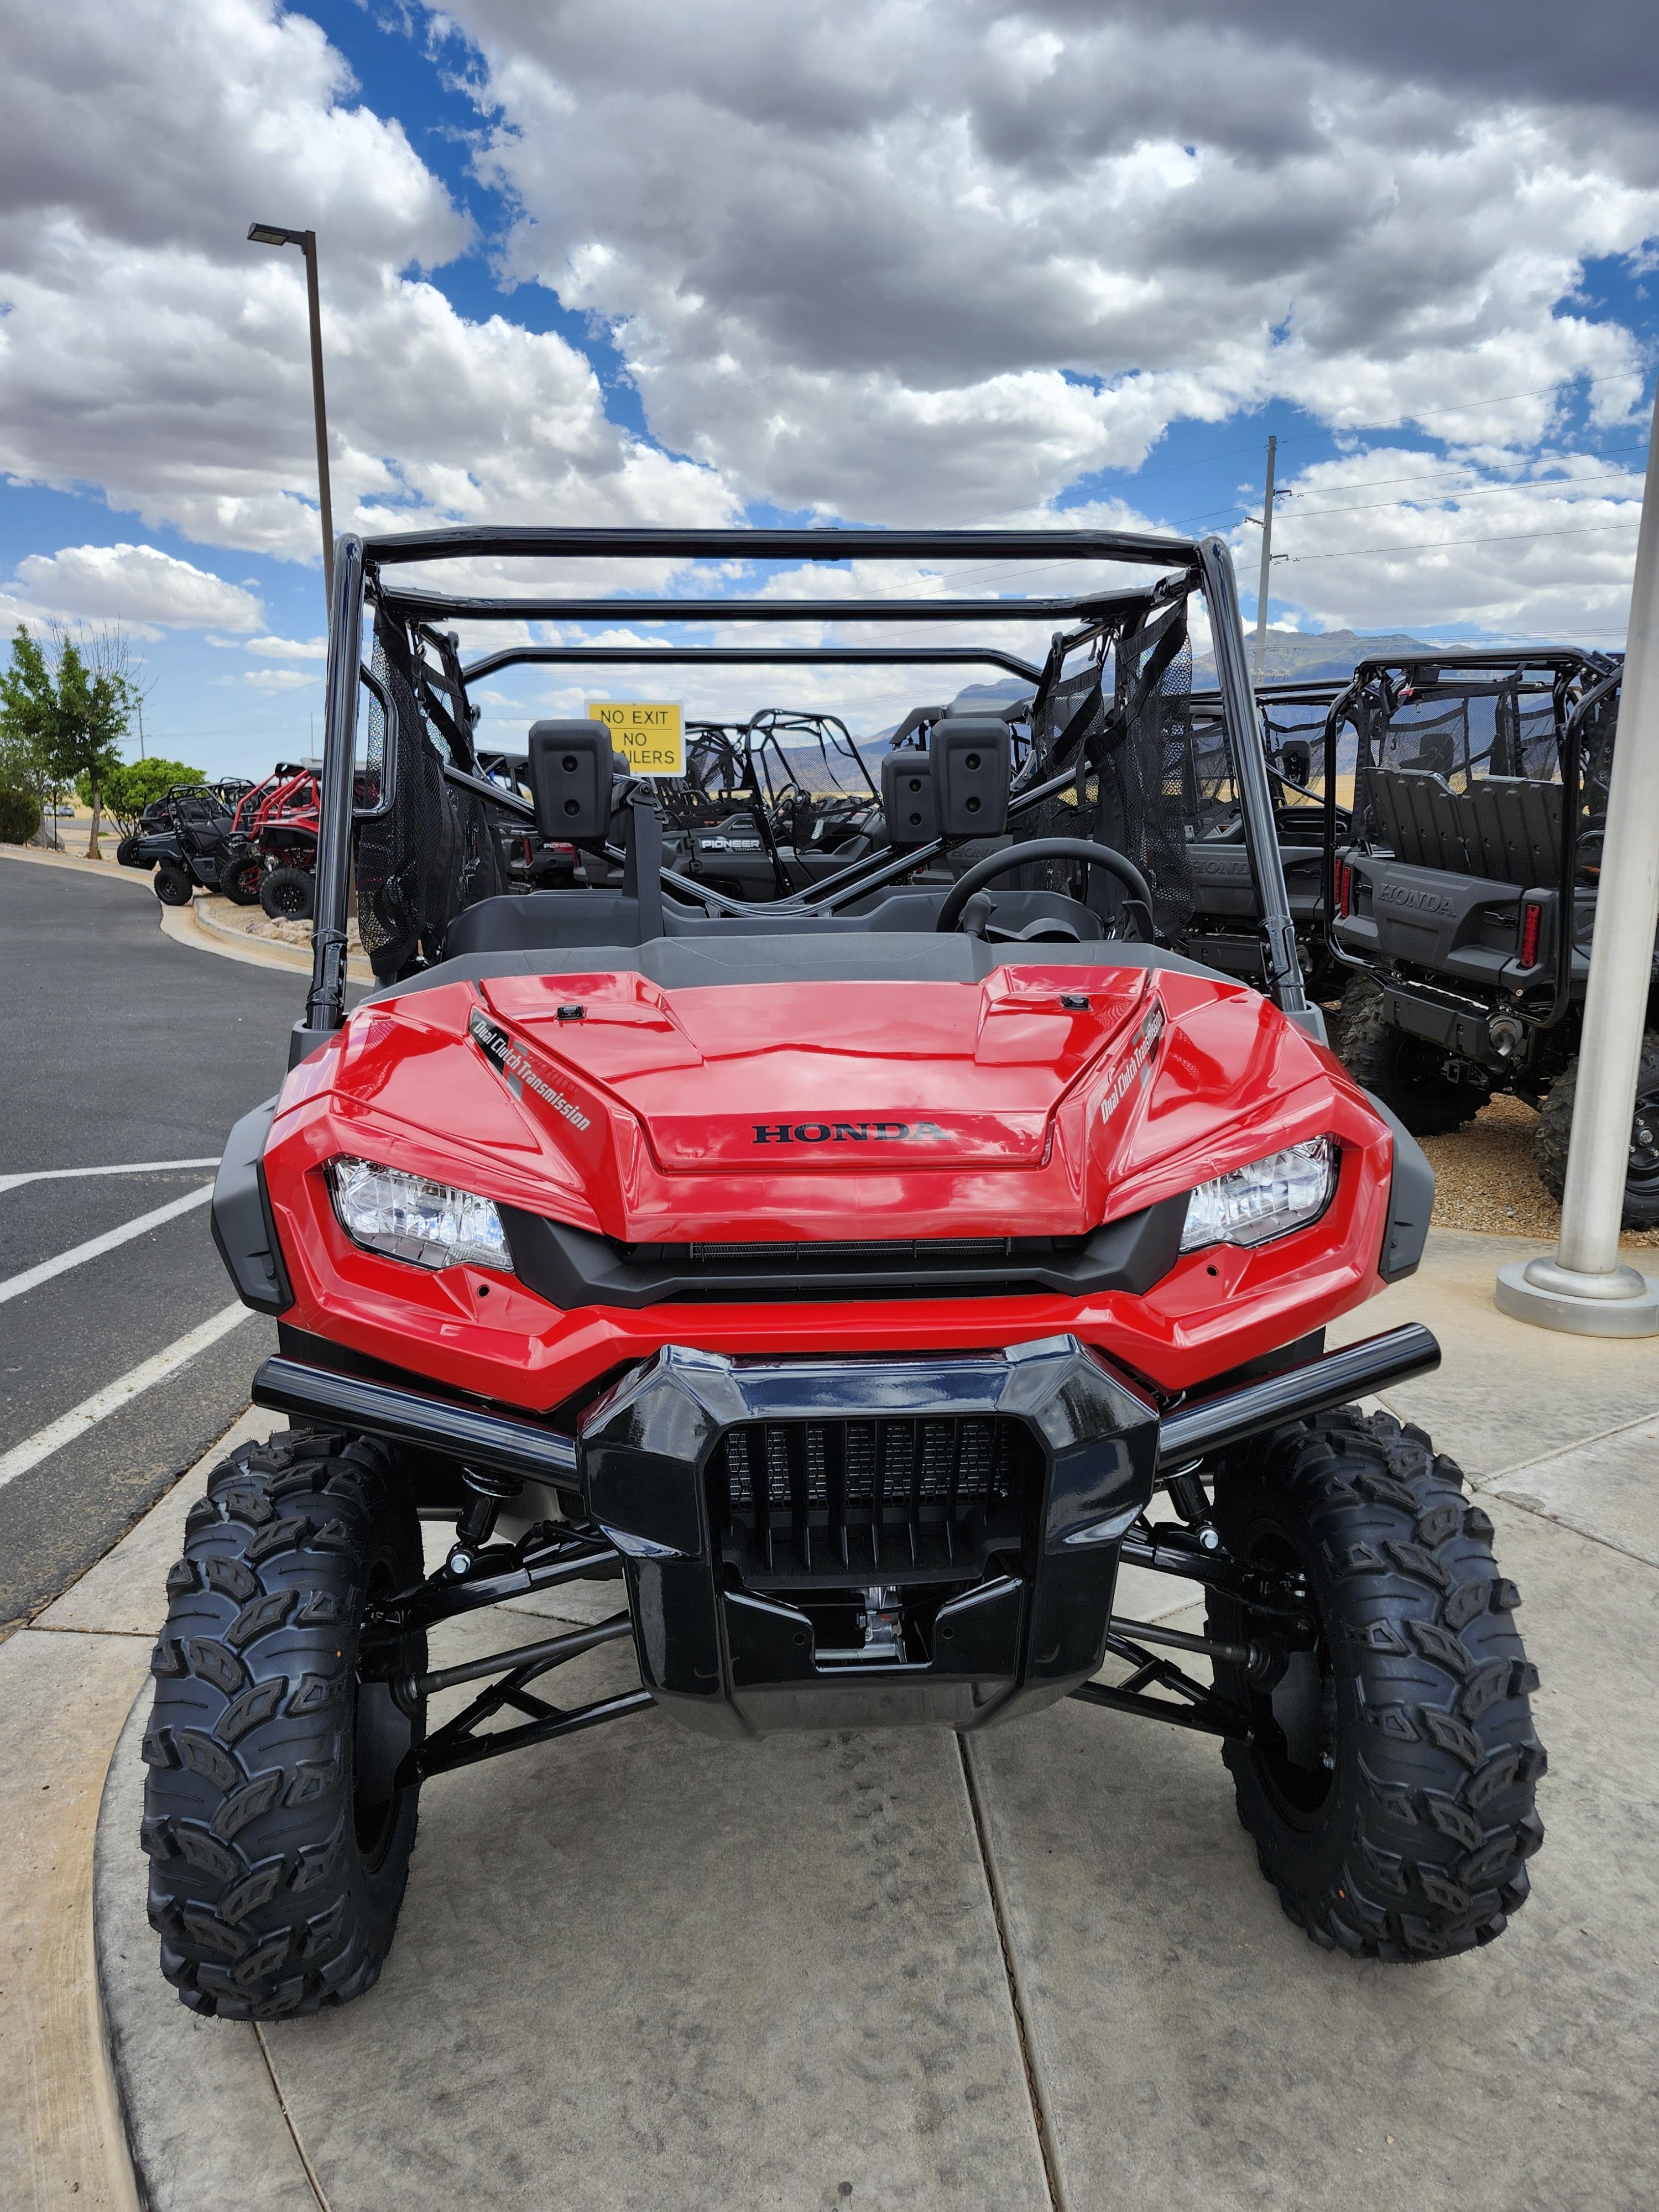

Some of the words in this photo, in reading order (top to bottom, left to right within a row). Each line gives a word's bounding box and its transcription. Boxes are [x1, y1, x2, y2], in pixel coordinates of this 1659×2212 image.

[601, 710, 624, 724] NO
[633, 711, 668, 724] EXIT
[624, 733, 646, 746] NO
[702, 840, 760, 848] PIONEER
[1188, 860, 1250, 875] HOND
[1377, 883, 1457, 917] HONDA
[473, 1020, 497, 1045] Dual
[491, 1037, 521, 1070] Clutch
[517, 1060, 591, 1131] Transmission
[1100, 1084, 1119, 1124] Dual
[1117, 1057, 1138, 1098] Clutch
[1134, 1010, 1164, 1069] Transmission
[752, 1122, 952, 1143] HONDA
